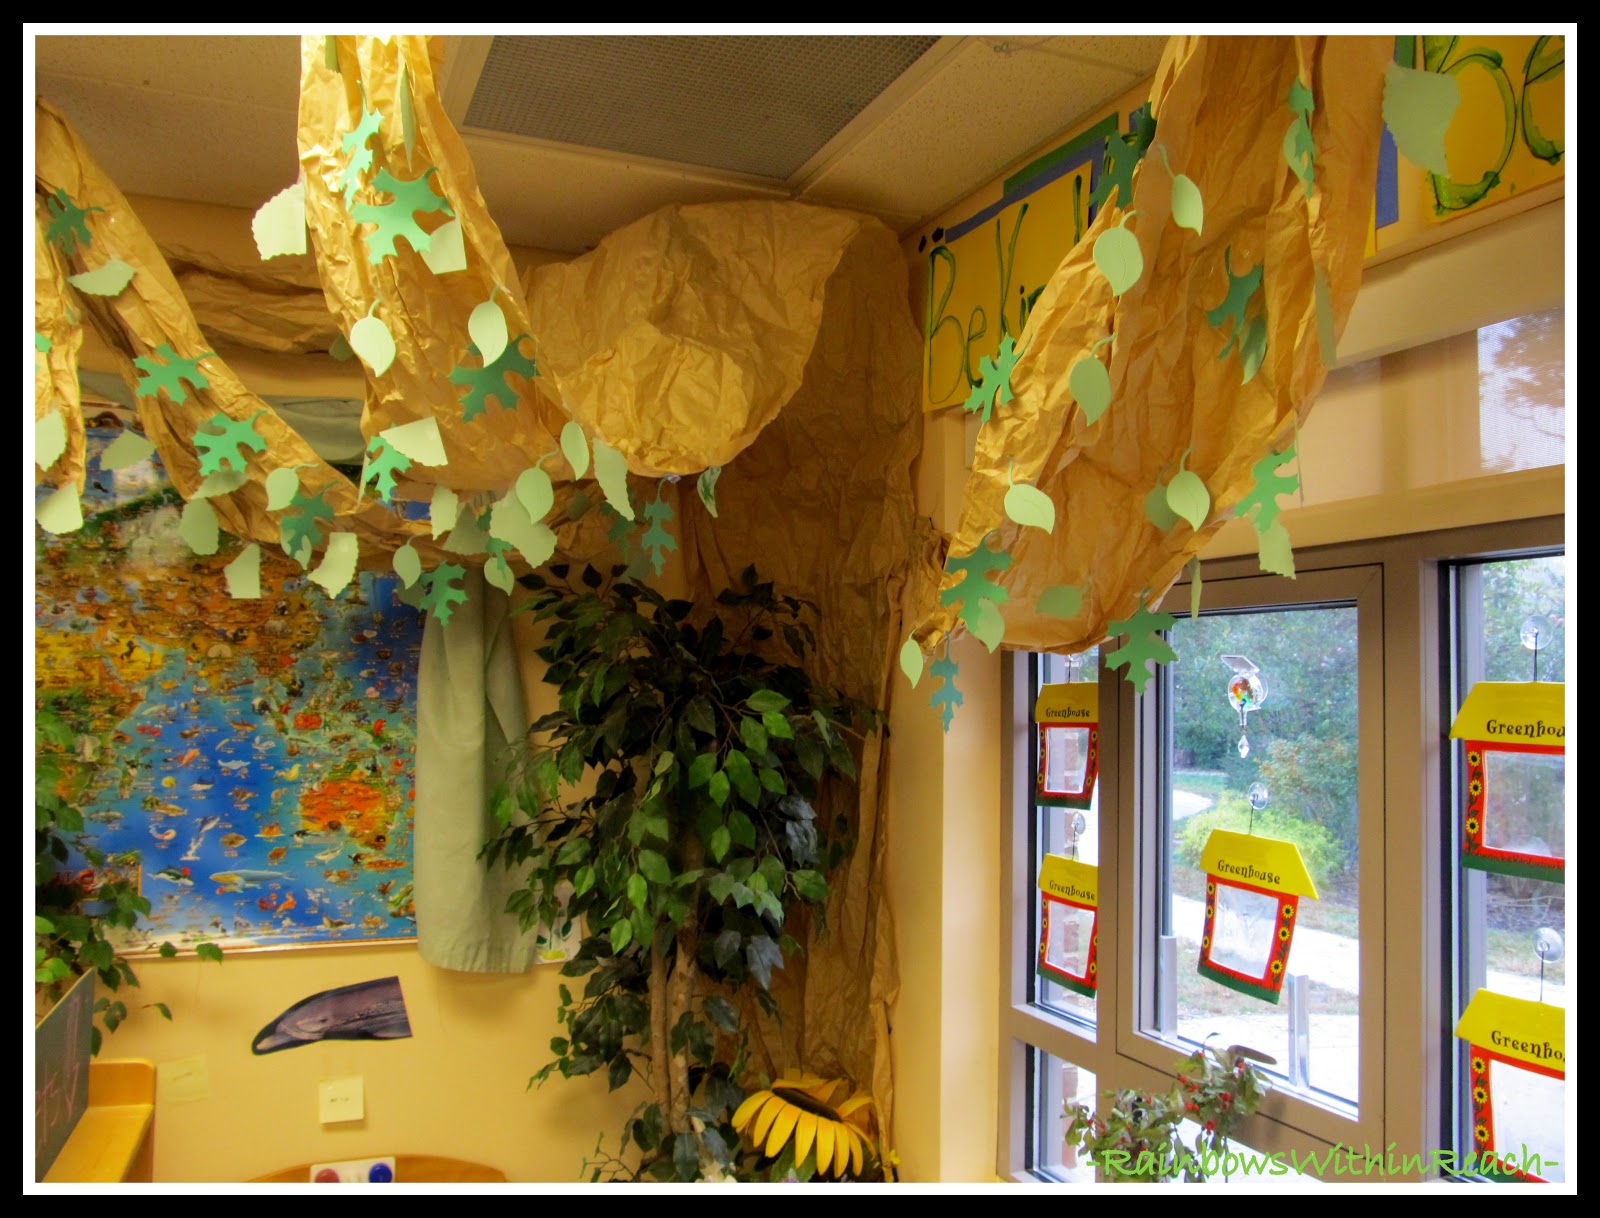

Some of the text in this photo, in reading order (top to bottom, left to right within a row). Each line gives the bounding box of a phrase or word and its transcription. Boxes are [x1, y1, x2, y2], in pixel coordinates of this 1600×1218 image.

[928, 245, 984, 404] Be
[1045, 706, 1091, 719] Greenhouse
[1217, 859, 1281, 885] Greenhouse
[1049, 879, 1096, 901] Greenhouse
[1491, 1030, 1565, 1062] Greenho
